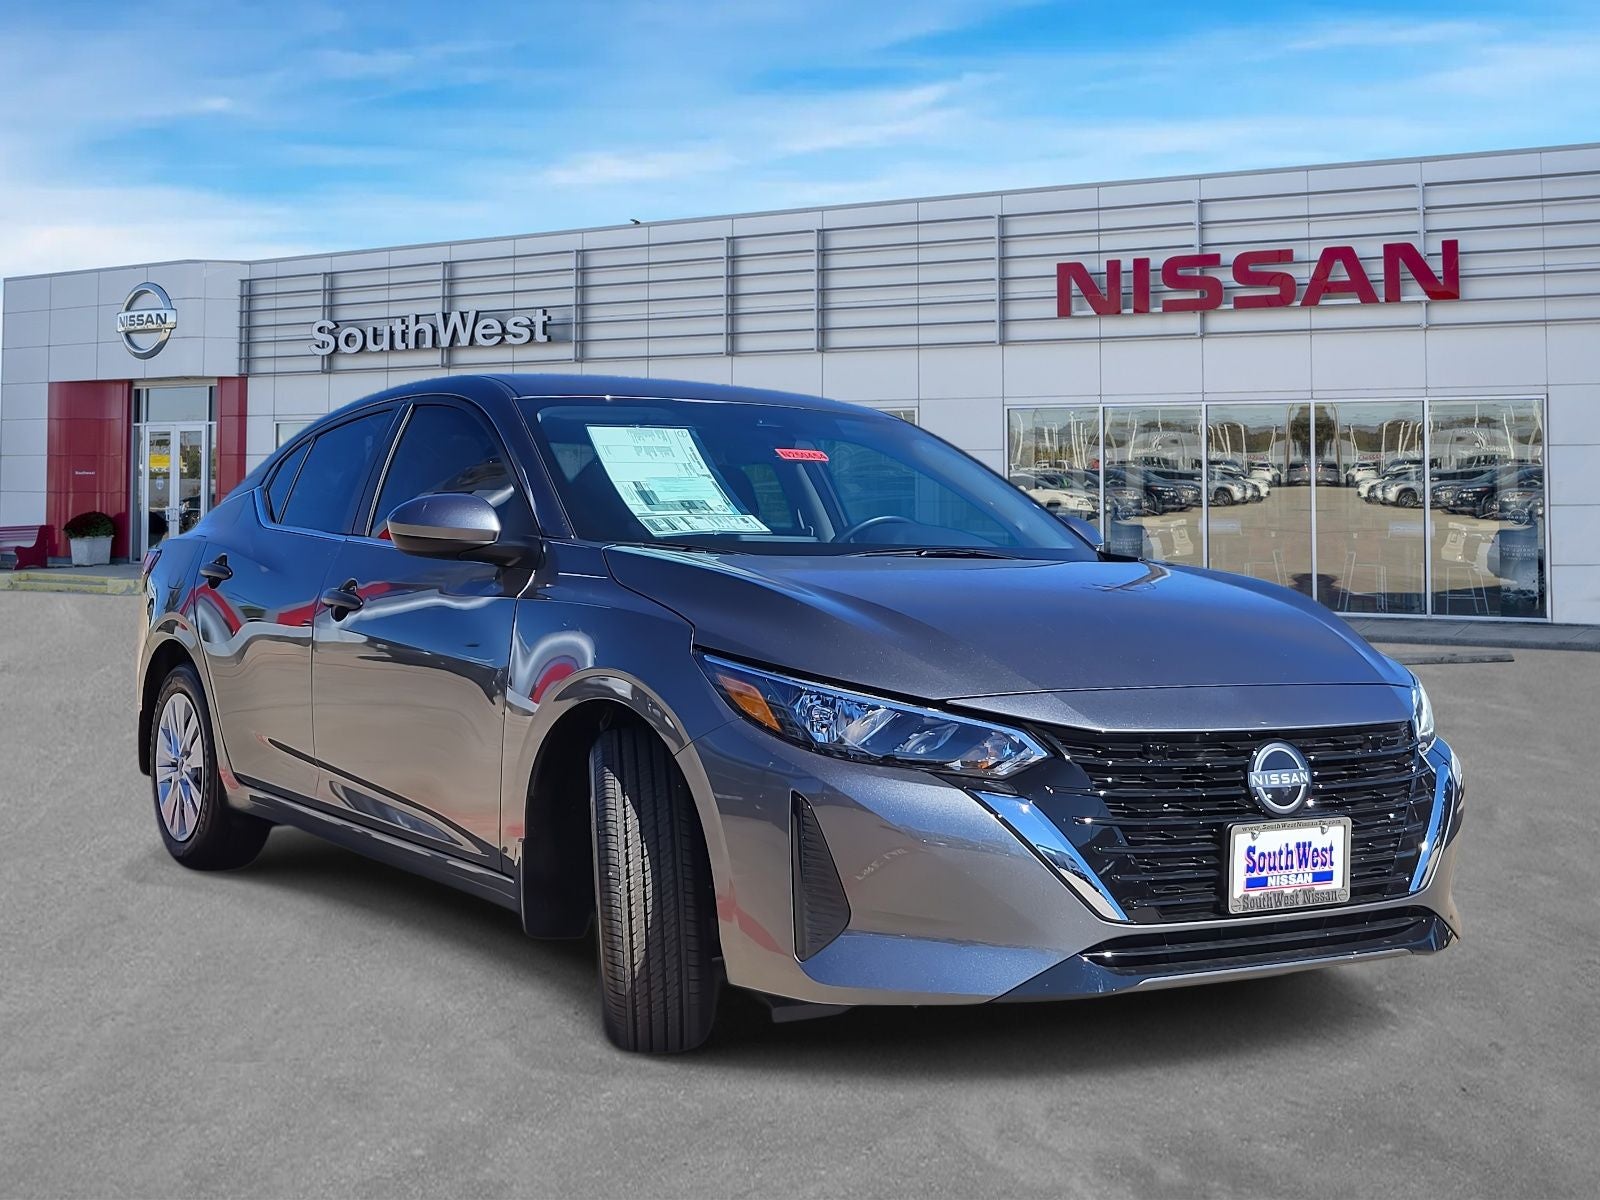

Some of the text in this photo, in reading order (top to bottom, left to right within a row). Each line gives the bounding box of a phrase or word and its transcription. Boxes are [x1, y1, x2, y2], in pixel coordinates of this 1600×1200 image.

[1056, 239, 1460, 317] NISSAN
[118, 312, 167, 328] NISSAN
[309, 308, 550, 356] SouthWest
[1251, 771, 1309, 785] NISSAN
[1245, 841, 1334, 874] SouthWest
[1267, 873, 1313, 886] NISSAN
[1242, 887, 1338, 911] SouthWest Nissan
